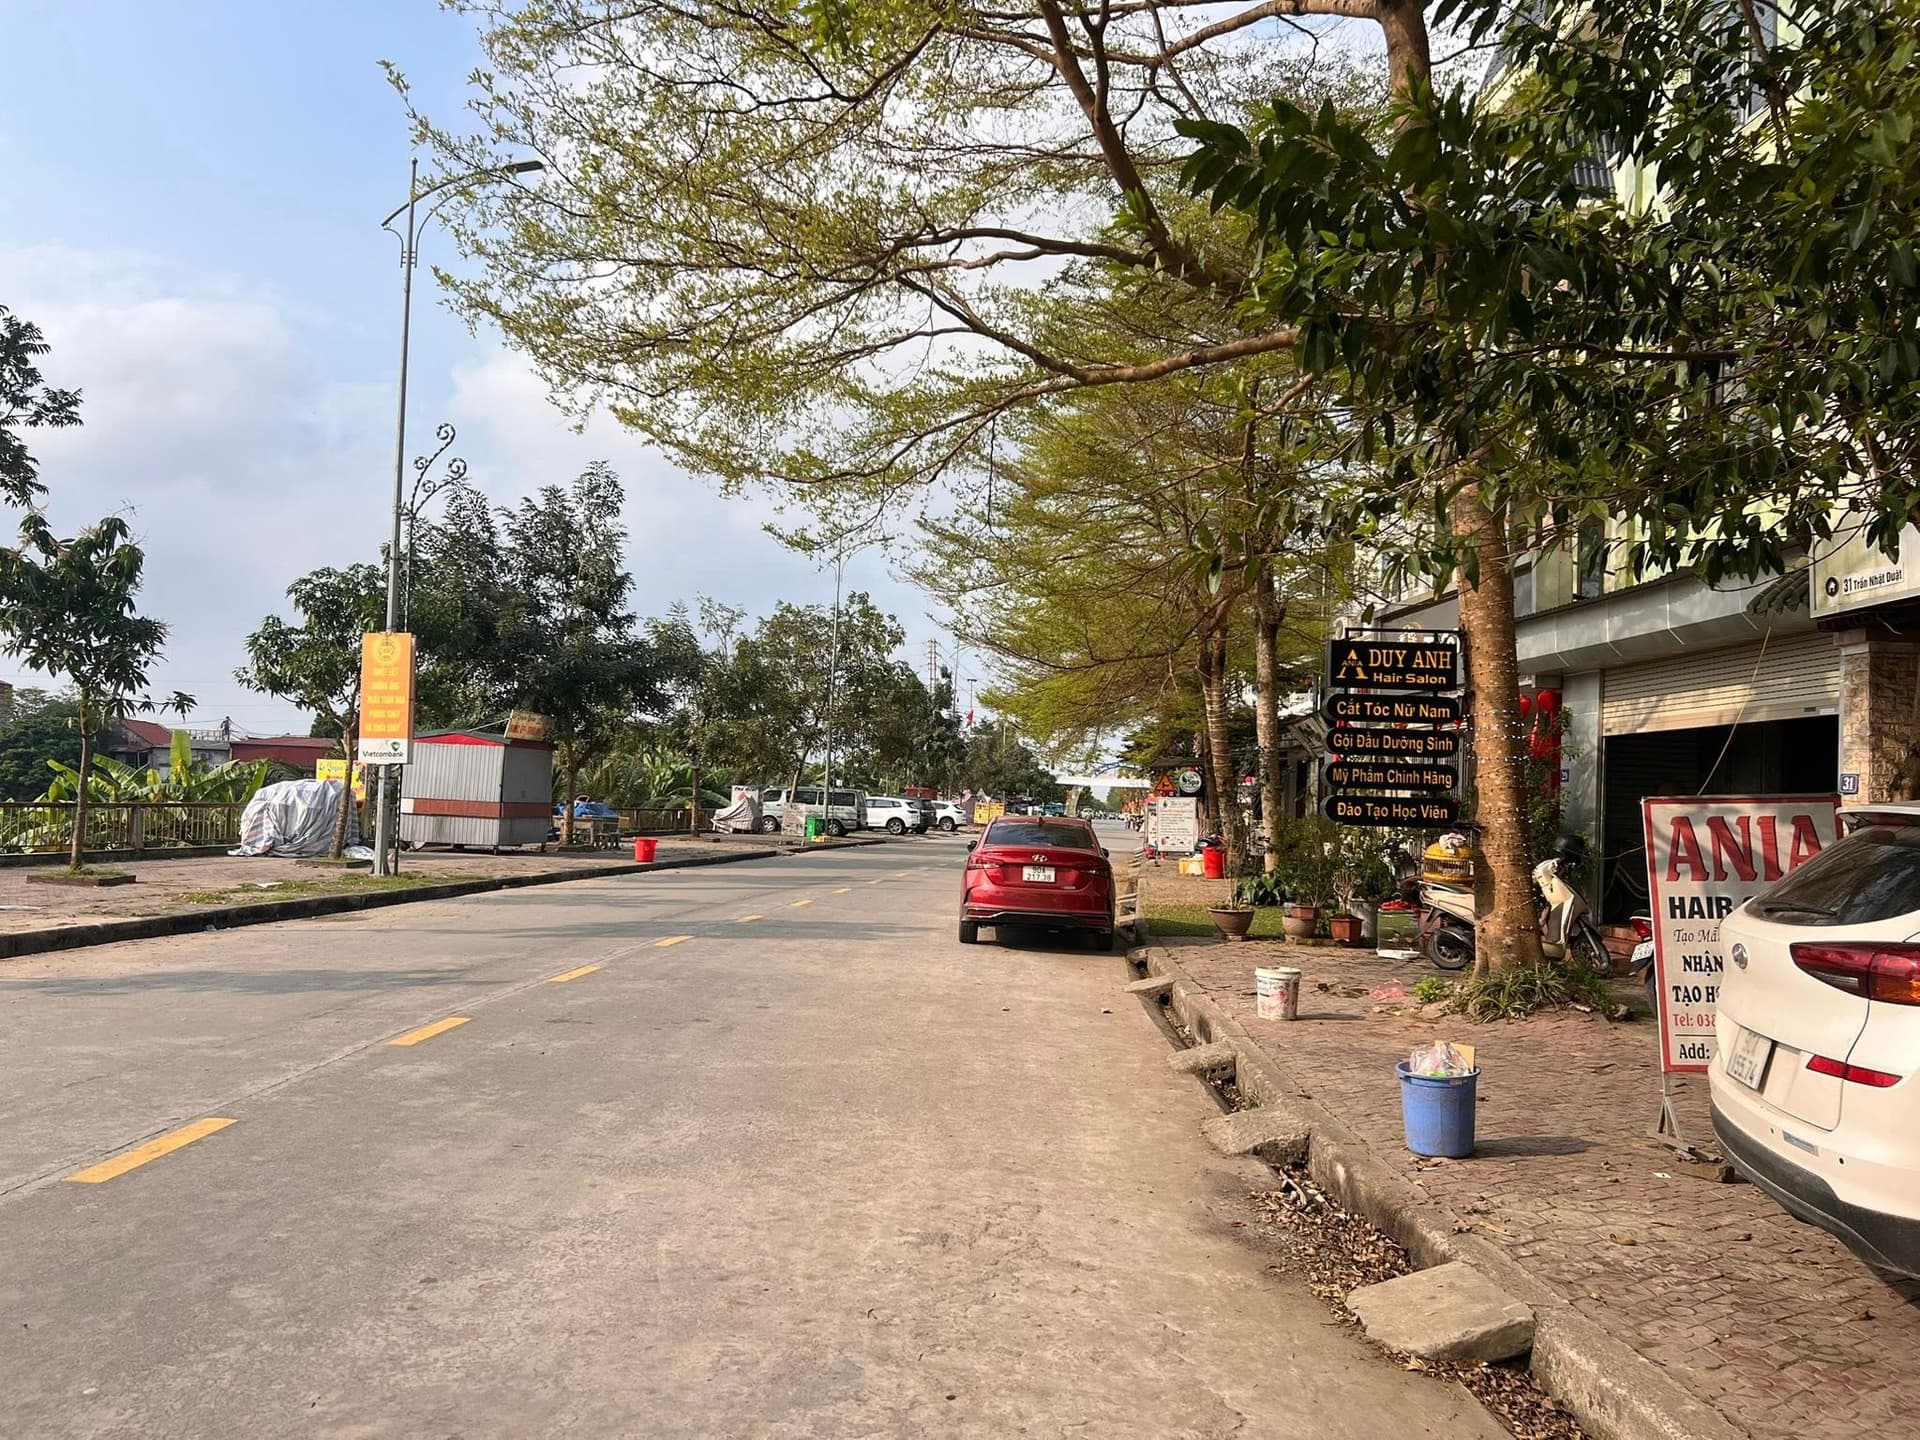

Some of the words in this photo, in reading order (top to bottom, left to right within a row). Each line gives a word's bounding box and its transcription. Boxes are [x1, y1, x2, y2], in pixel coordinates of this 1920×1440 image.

[1843, 578, 1853, 592] 31
[1368, 649, 1407, 668] DUY
[1411, 650, 1453, 669] ANH
[1373, 672, 1403, 684] Hair
[1405, 673, 1447, 685] Salon
[1336, 698, 1361, 715] Cắt
[1363, 701, 1391, 717] Tóc
[1394, 703, 1416, 718] Nữ
[1419, 704, 1451, 719] Nam
[1332, 733, 1354, 750] Gội
[1356, 731, 1380, 749] Đầu
[1382, 735, 1424, 753] Dưỡng
[1426, 736, 1453, 751] Sinh
[362, 750, 404, 758] Vietcombank
[1332, 767, 1350, 785] Mỹ
[1351, 765, 1384, 783] Phẩm
[1423, 770, 1453, 789] Hãng
[1842, 777, 1855, 790] 31
[1337, 801, 1362, 817] Đào
[1364, 802, 1389, 820] Tạo
[1392, 803, 1417, 821] Học
[1420, 803, 1449, 819] Viên
[1666, 815, 1823, 882] ANIA
[1668, 896, 1733, 919] HAIR
[1673, 928, 1695, 945] Tạo
[1682, 950, 1724, 976] NHẬN
[1672, 985, 1702, 1007] TẠO
[1673, 1013, 1694, 1027] Tel:
[1679, 1043, 1710, 1060] Add:
